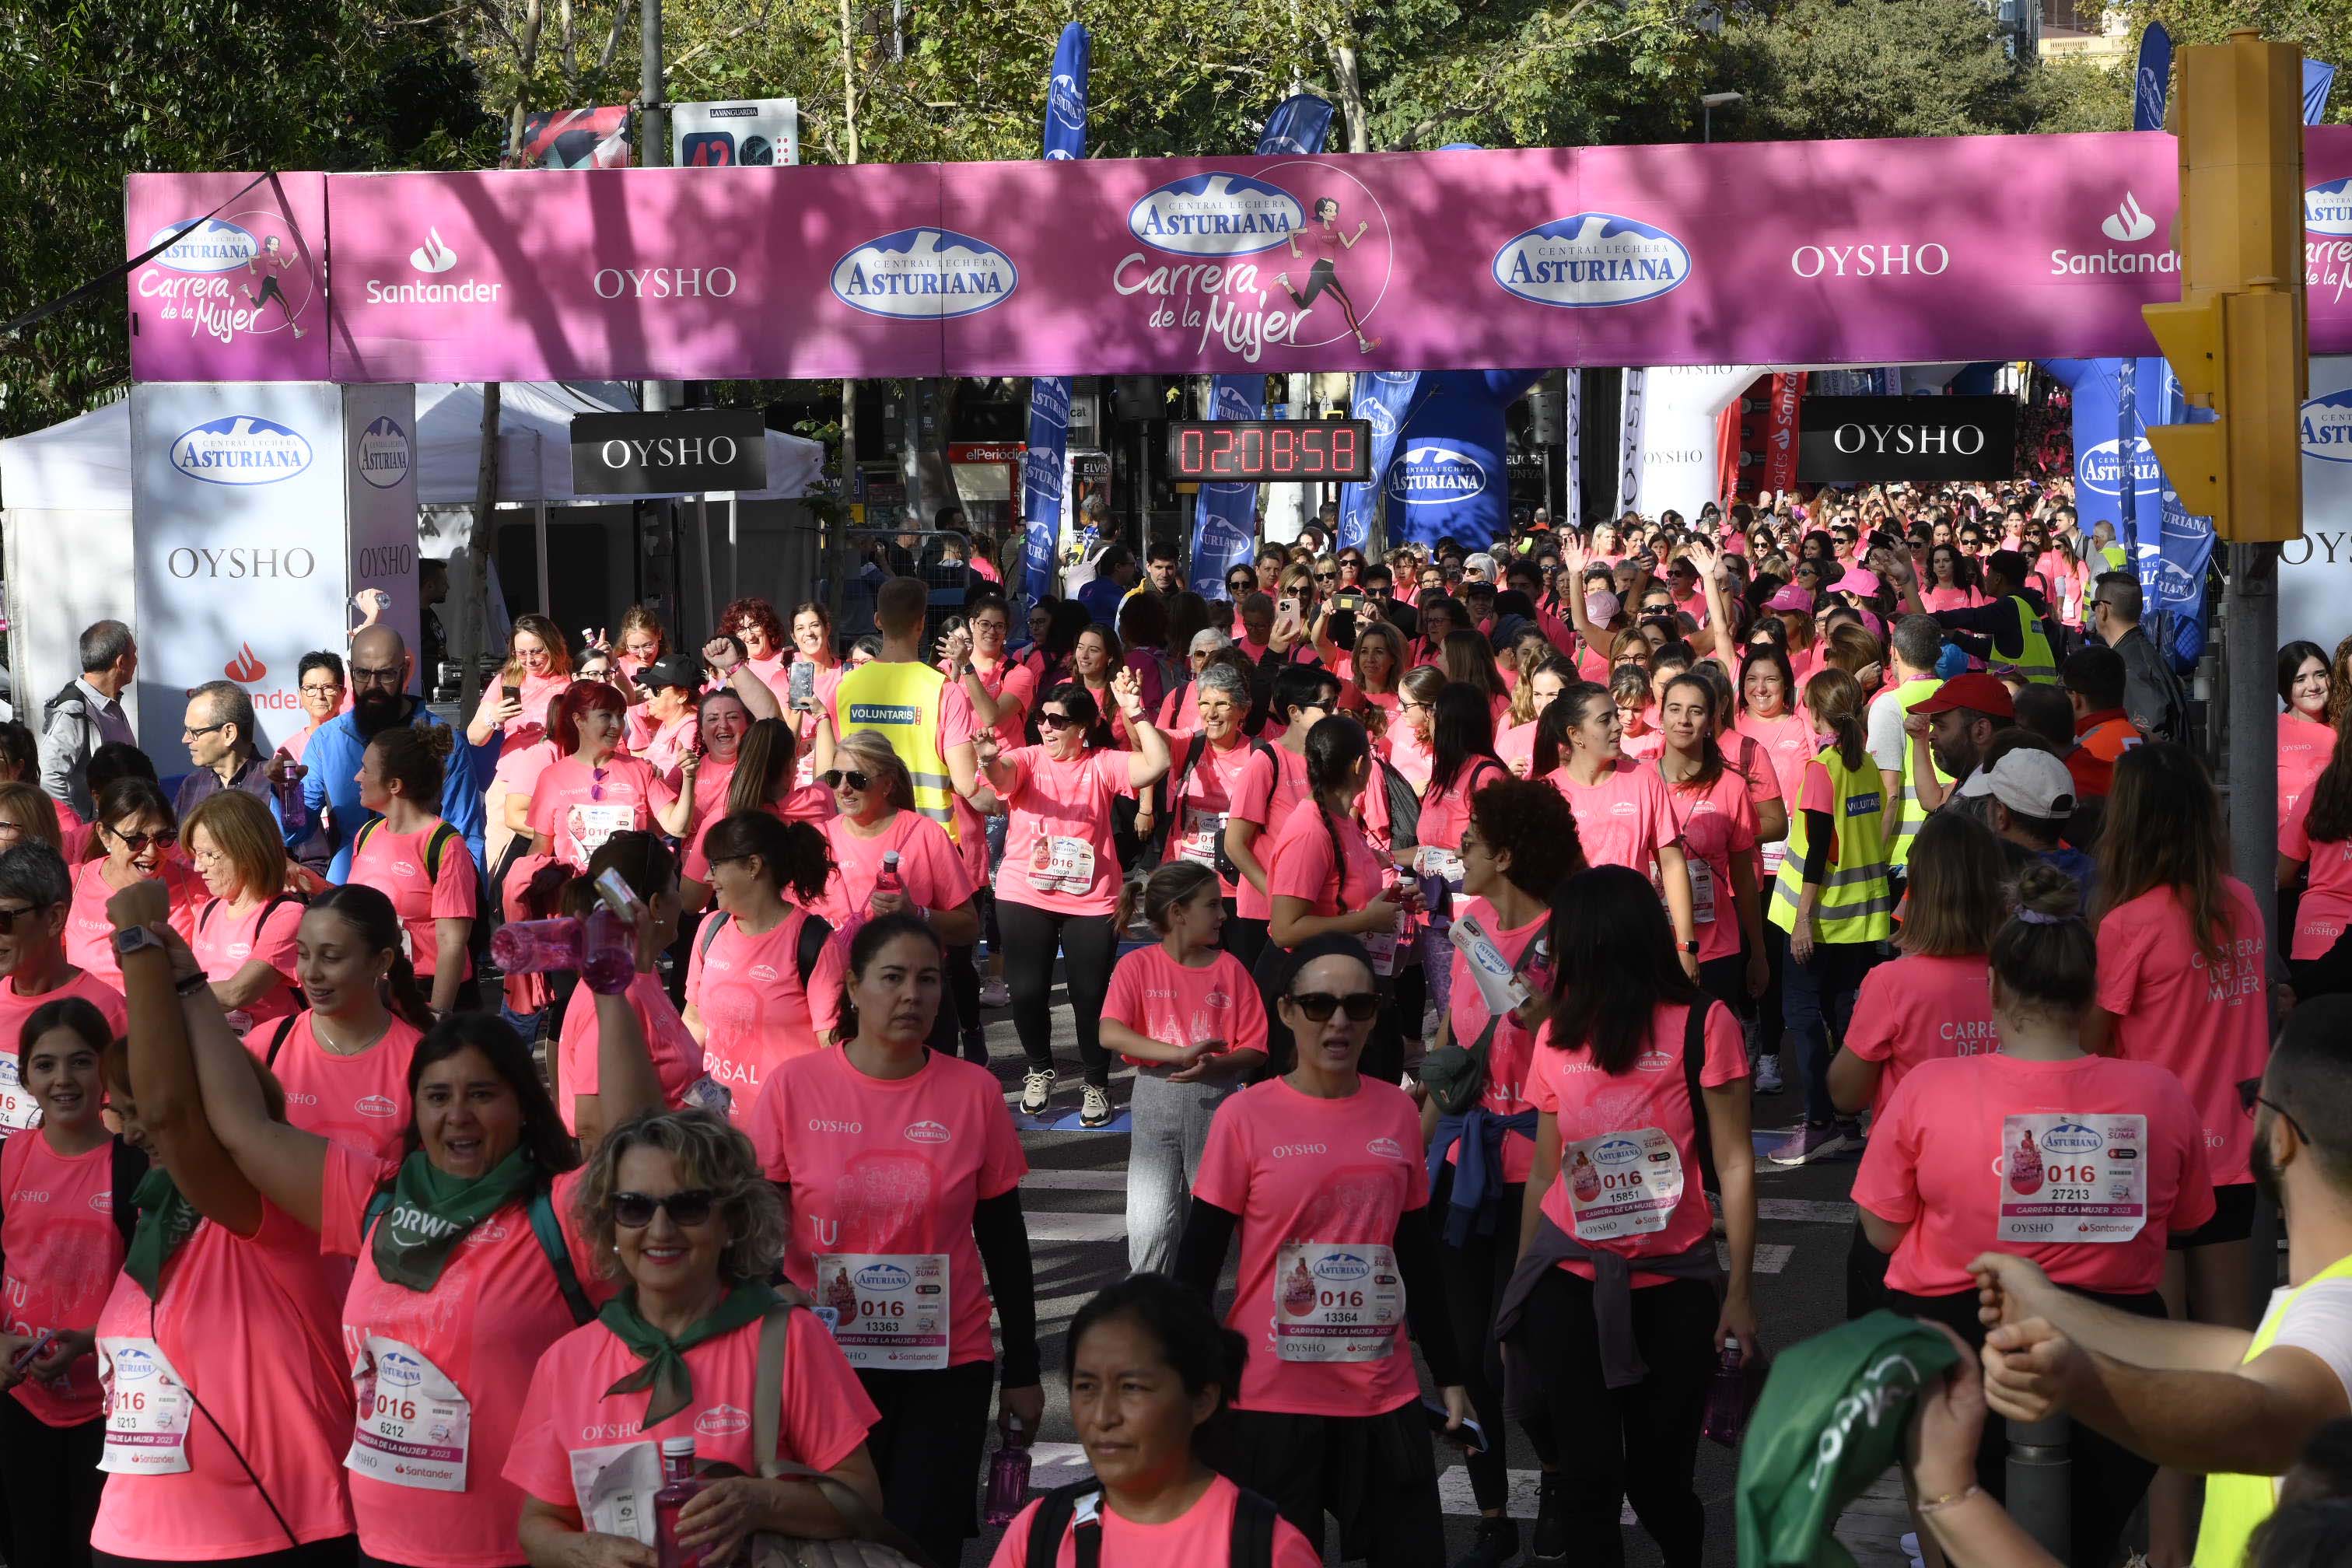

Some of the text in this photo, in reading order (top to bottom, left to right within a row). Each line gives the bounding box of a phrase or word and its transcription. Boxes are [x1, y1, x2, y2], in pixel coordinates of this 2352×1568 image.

[1169, 199, 1286, 210] CENTRAL LECHERA
[1141, 204, 1291, 236] ASTURIANA
[156, 238, 249, 258] ASTURIANA
[1538, 243, 1668, 256] CENTRAL LECHERA
[873, 258, 996, 269] CENTRAL LECHERA
[1508, 250, 1675, 284] ASTURIANA
[1792, 243, 1949, 278] OYSHO
[845, 262, 1003, 296] ASTURIANA
[1113, 253, 1258, 296] Carrera
[2324, 264, 2337, 285] la
[138, 270, 229, 299] Carrera
[593, 267, 737, 299] OYSHO
[366, 280, 502, 304] Santander
[161, 296, 264, 342] de la Mujer
[1149, 289, 1313, 363] de la Mujer
[1069, 407, 1087, 418] cat
[1834, 423, 1985, 455] OYSHO
[181, 442, 303, 467] ASTURIANA
[362, 443, 407, 471] ASTURIANA
[601, 436, 737, 468] OYSHO
[1181, 429, 1355, 472] 02:08:58
[1643, 449, 1703, 465] OYSHO
[1083, 463, 1108, 473] ELVIS
[1388, 468, 1479, 489] ASTURIANA
[168, 548, 315, 579] OYSHO
[359, 544, 411, 579] OYSHO
[851, 709, 914, 720] VOLUNTARIS
[2282, 744, 2312, 752] OYSHO
[1030, 821, 1048, 836] TU
[1052, 859, 1073, 868] 016
[2305, 926, 2339, 936] OYSHO
[1478, 943, 1509, 972] ASTURIANA
[2210, 958, 2254, 983] DE LA
[2207, 976, 2260, 1003] MUJER
[1958, 1041, 1978, 1058] DE
[359, 1102, 394, 1113] ASTURIANA
[809, 1119, 862, 1134] OYSHO
[907, 1129, 948, 1139] ASTURIANA
[1644, 1139, 1667, 1148] SUMA
[2046, 1136, 2098, 1147] ASTURIANA
[1272, 1143, 1328, 1158] OYSHO
[1597, 1148, 1639, 1161] ASTURIANA
[1604, 1171, 1643, 1188] 016
[2048, 1165, 2095, 1183] 016
[1610, 1191, 1640, 1203] 15851
[2052, 1189, 2090, 1200] 27213
[1586, 1209, 1614, 1218] CARRERA
[1634, 1202, 1657, 1210] MUJER
[810, 1215, 838, 1245] TU
[1586, 1221, 1617, 1234] OYSHO
[2011, 1223, 2134, 1234] OYSHO Santander
[1318, 1264, 1365, 1276] ASTURIANA
[858, 1274, 906, 1285] ASTURIANA
[5, 1276, 28, 1308] TU
[1321, 1291, 1363, 1307] 016
[861, 1300, 905, 1317] 016
[1325, 1312, 1358, 1323] 13364
[865, 1322, 899, 1332] 13363
[1286, 1342, 1325, 1353] OYSHO
[899, 1352, 939, 1361] Santander
[376, 1395, 416, 1421] 016
[380, 1422, 404, 1438] 6212
[699, 1417, 747, 1430] ASTURIANA
[157, 1436, 174, 1444] 2023
[378, 1439, 388, 1449] DE
[388, 1441, 398, 1451] LA
[399, 1443, 428, 1455] MUJER
[431, 1449, 452, 1458] 2023
[406, 1465, 453, 1479] Santander
